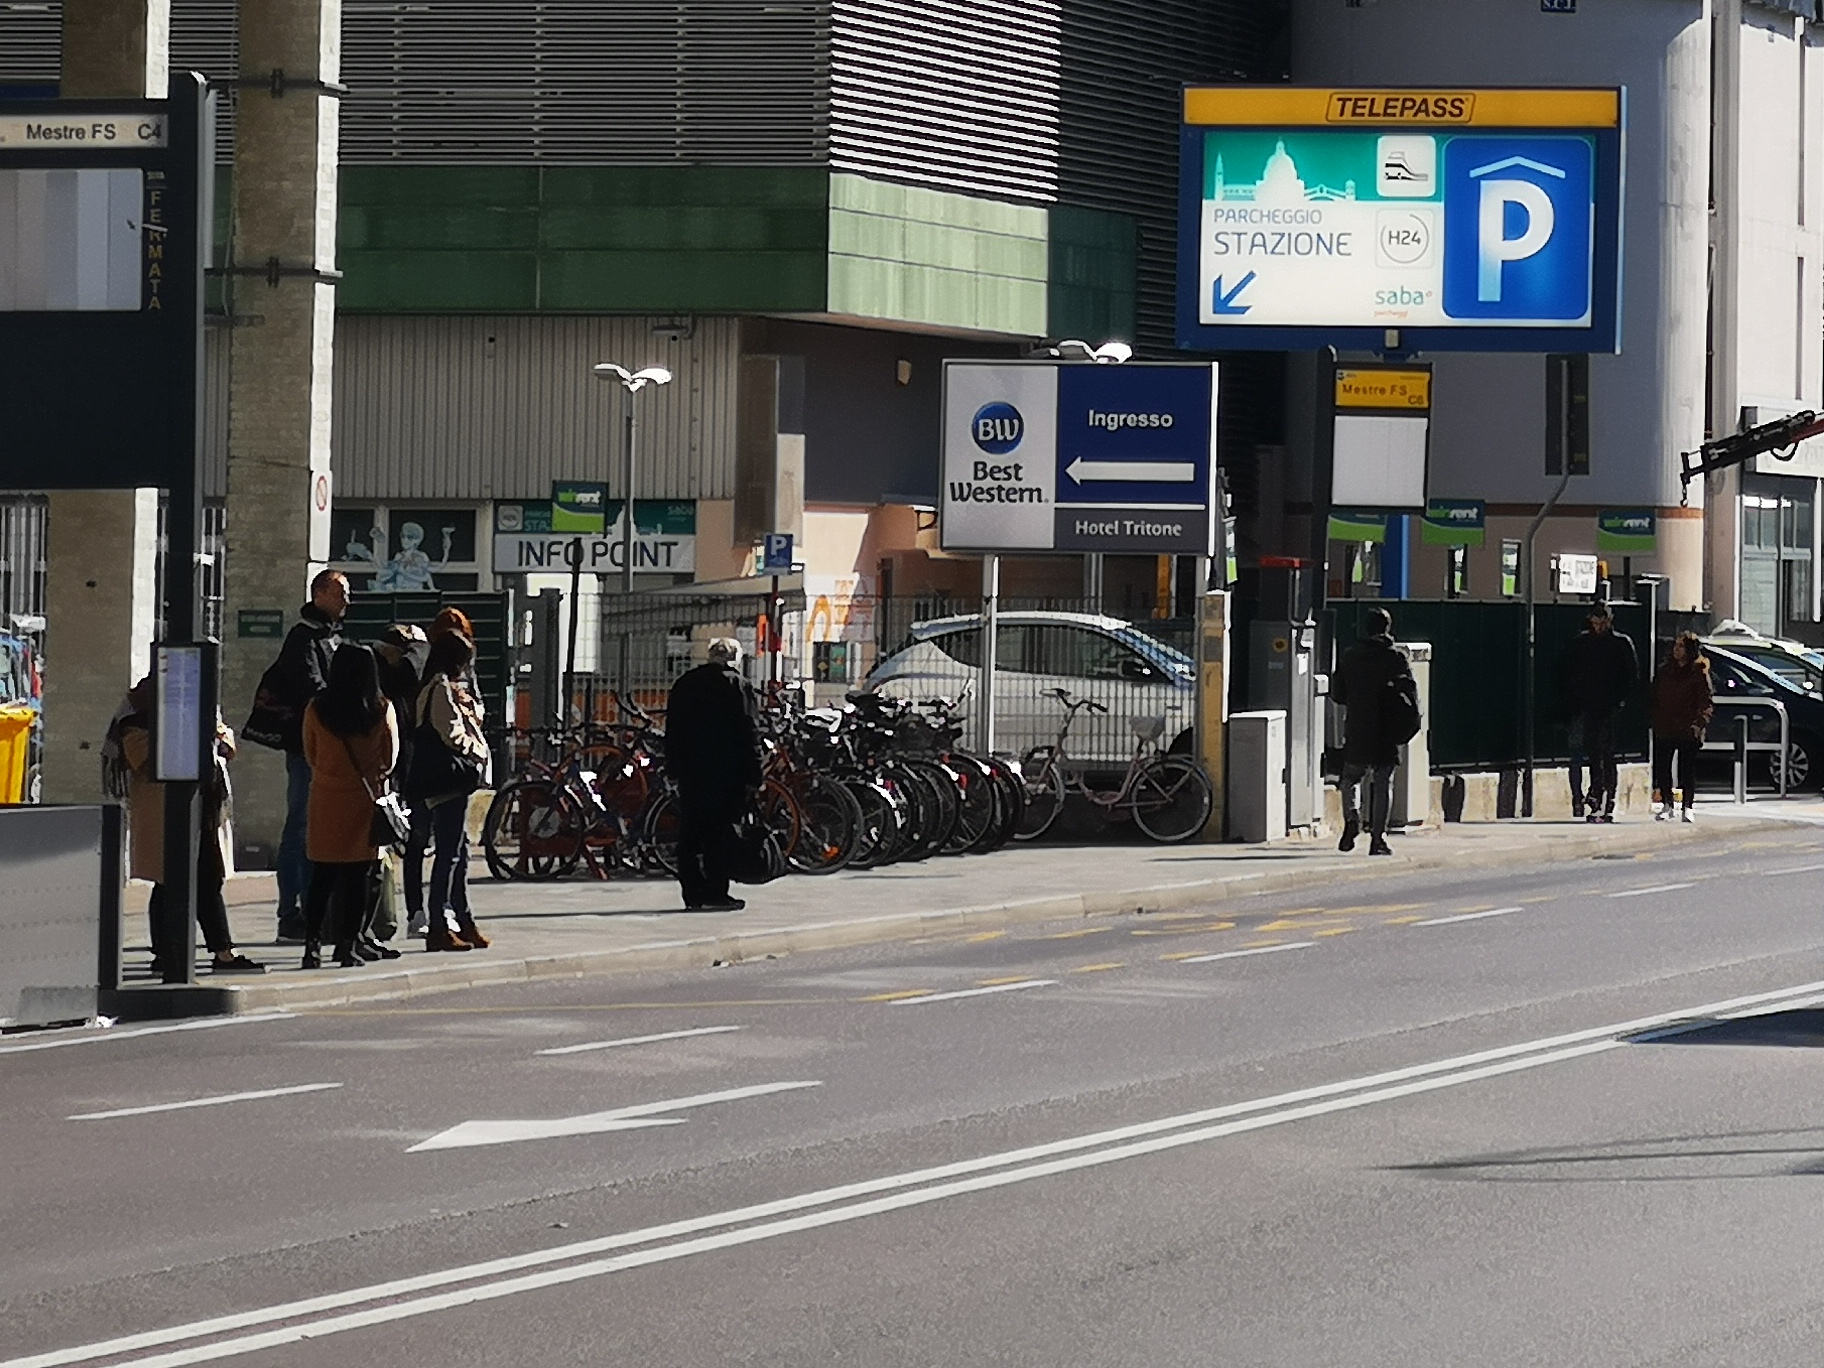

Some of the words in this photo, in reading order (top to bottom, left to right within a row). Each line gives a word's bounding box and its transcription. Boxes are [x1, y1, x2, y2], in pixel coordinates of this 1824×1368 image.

[1335, 97, 1466, 119] TELEPASS
[26, 123, 86, 140] Mestre
[92, 123, 116, 140] FS
[137, 123, 162, 140] C4
[1213, 208, 1323, 225] PARCHEGGIO
[1213, 231, 1352, 257] STAZIONE
[1388, 230, 1422, 246] H24
[1478, 179, 1555, 302] P
[1342, 384, 1386, 396] Mestre
[1390, 384, 1407, 396] FS
[977, 418, 1020, 442] BW
[1088, 409, 1173, 431] Ingresso
[973, 461, 1023, 482] Best
[950, 483, 1043, 504] Western
[1075, 519, 1119, 536] Hotel
[1123, 520, 1182, 537] Tritone
[518, 540, 584, 568] INFO
[591, 540, 679, 568] POINT
